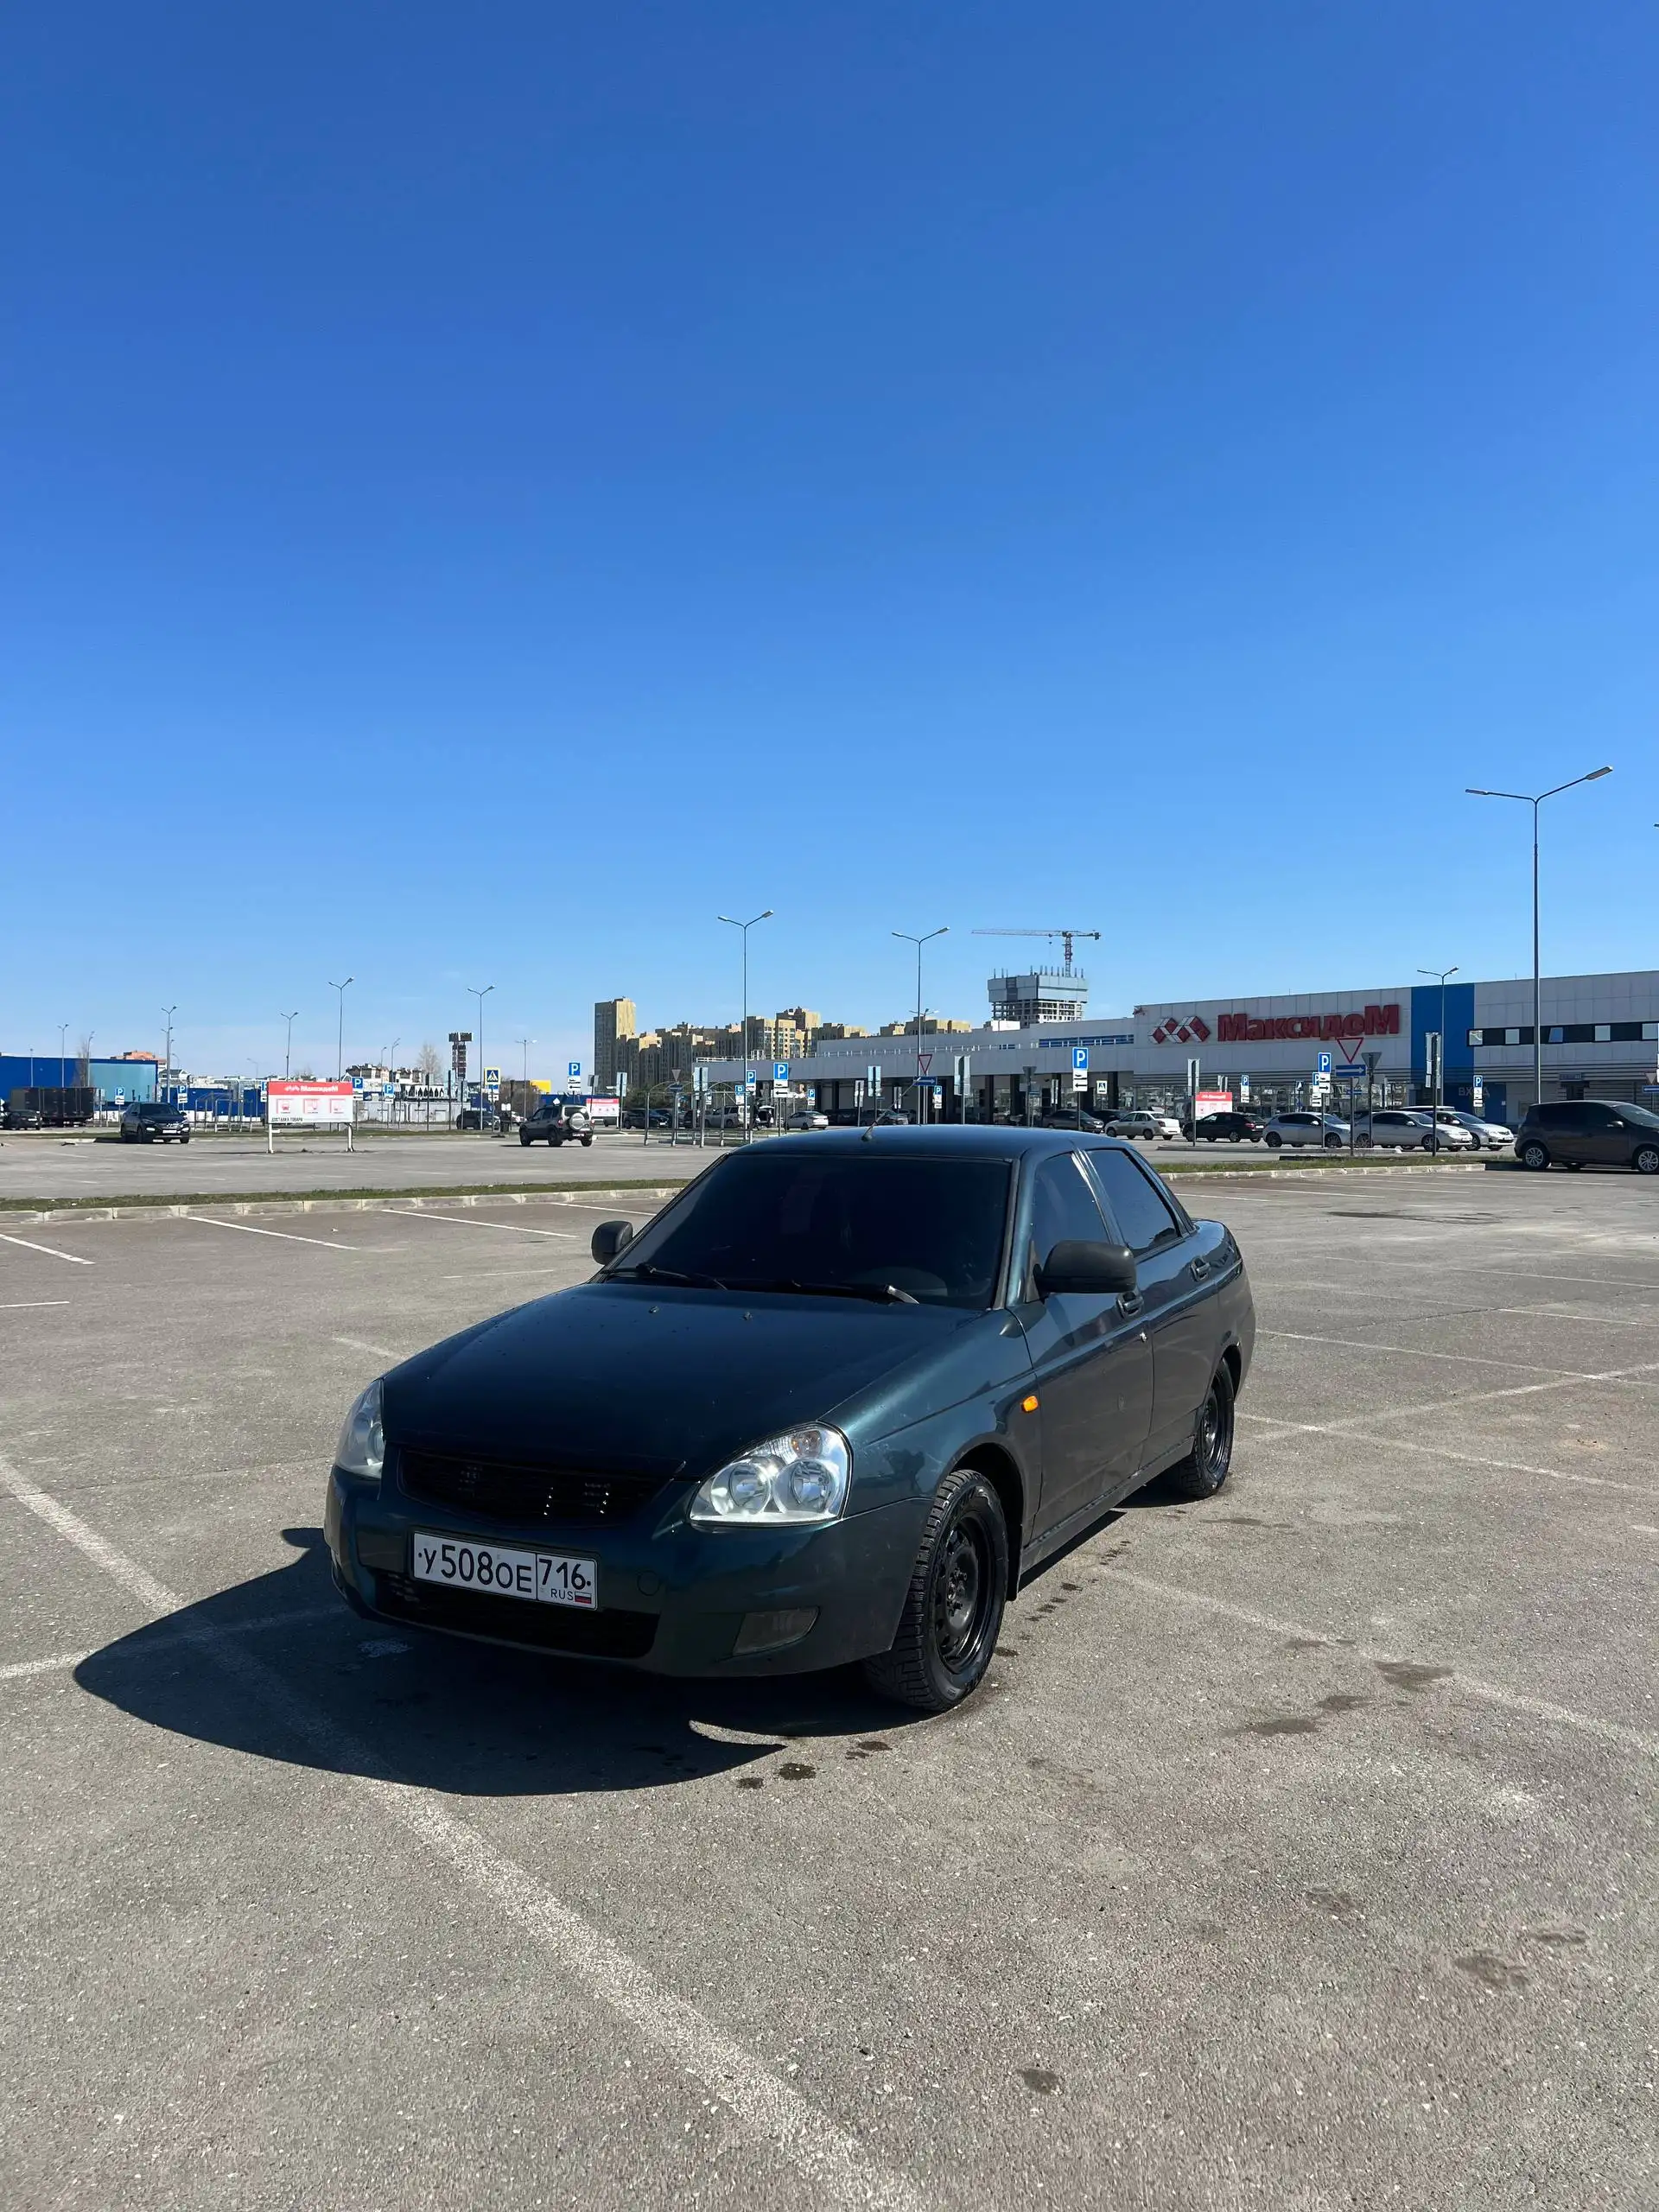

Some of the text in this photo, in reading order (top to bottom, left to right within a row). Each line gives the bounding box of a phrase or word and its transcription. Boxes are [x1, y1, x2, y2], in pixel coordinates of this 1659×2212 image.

[1217, 1004, 1400, 1041] МаксидоМ
[1077, 1050, 1085, 1067] P
[1322, 1055, 1329, 1071] P
[571, 1064, 579, 1075] P
[777, 1065, 785, 1078] P
[1458, 1086, 1491, 1098] ВХД
[538, 1558, 587, 1591] 716
[550, 1587, 575, 1602] RUS
